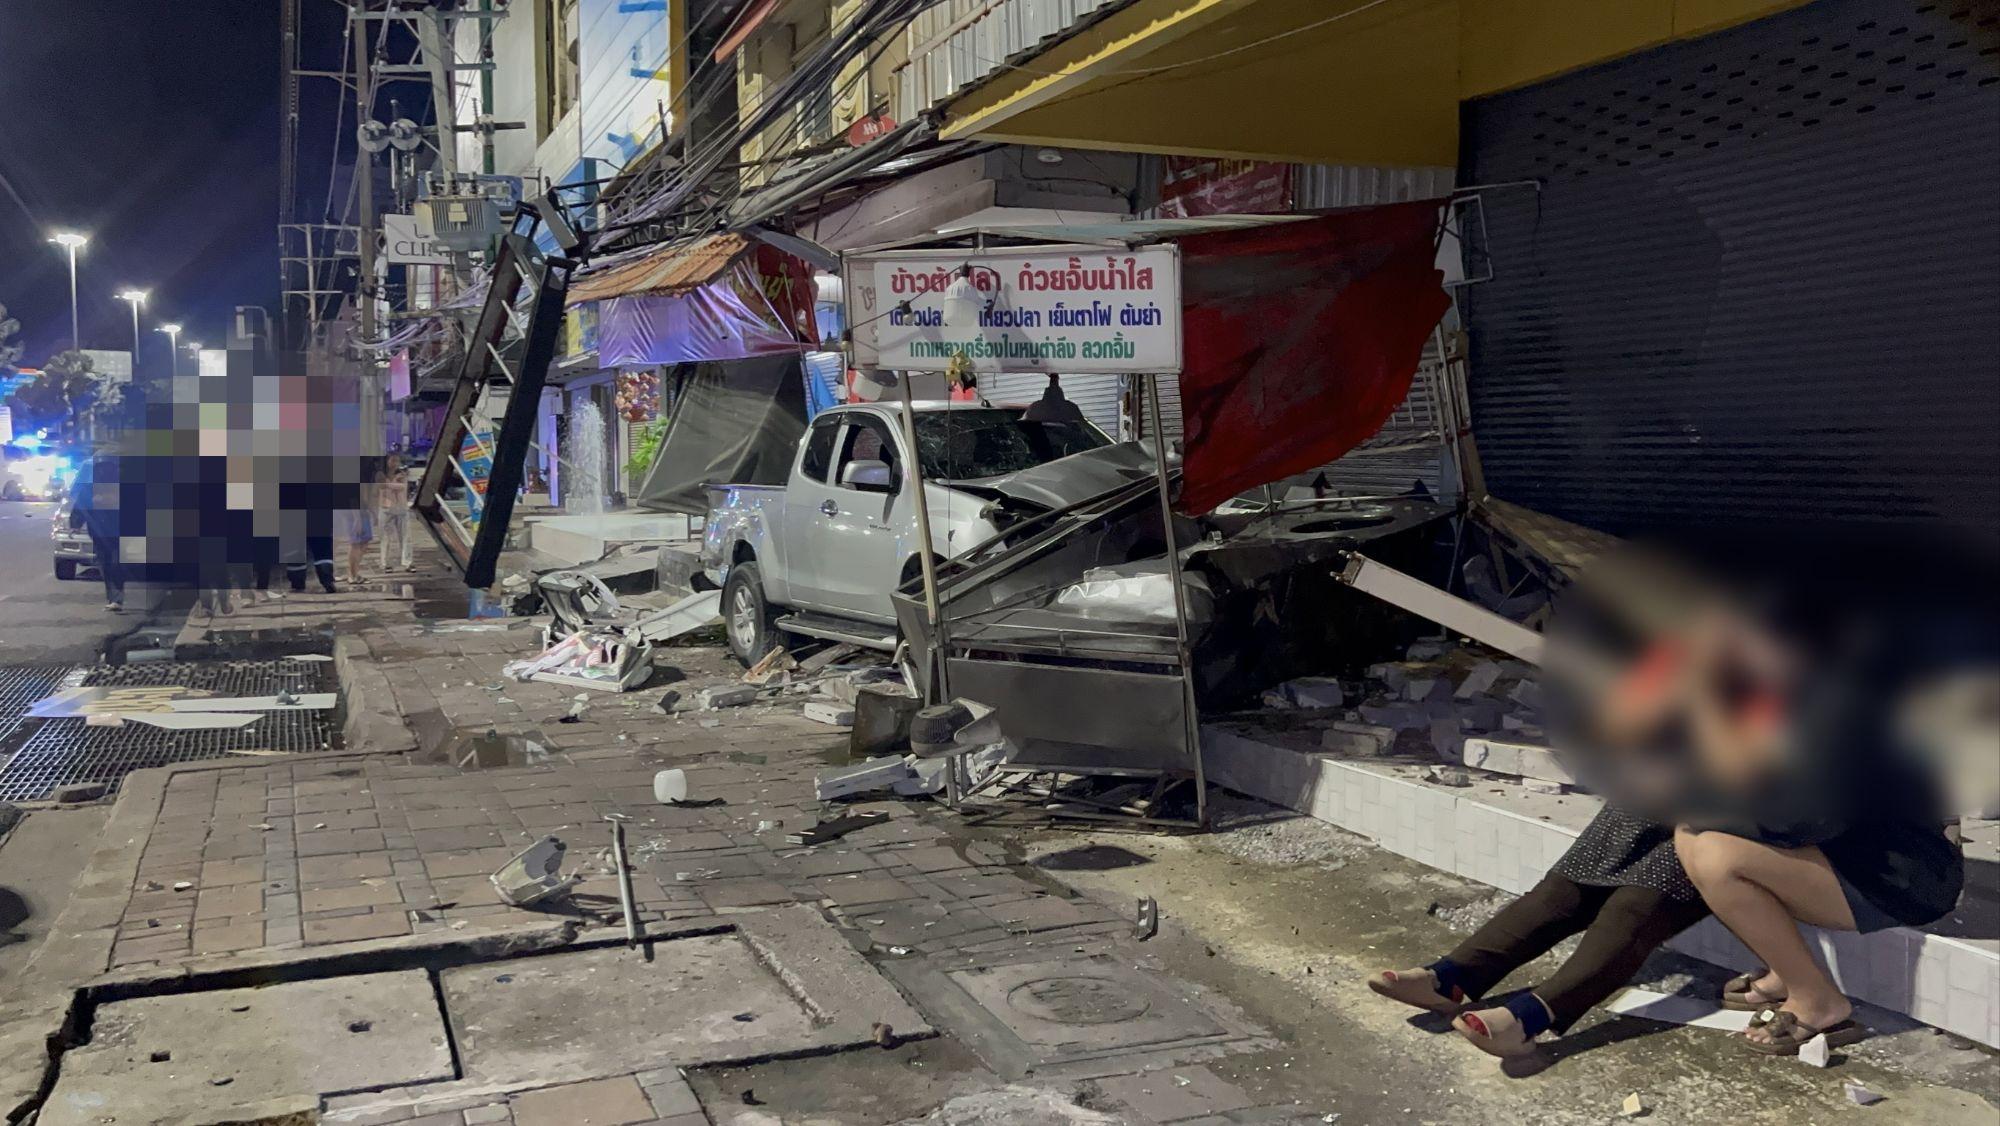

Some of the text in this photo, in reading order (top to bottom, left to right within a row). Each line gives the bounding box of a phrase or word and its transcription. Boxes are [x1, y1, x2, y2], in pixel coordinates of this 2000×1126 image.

[1049, 301, 1111, 326] เย็นตาโฟ
[1120, 302, 1161, 326] ต้มยำ
[1082, 332, 1135, 358] ลวกจิ้ม
